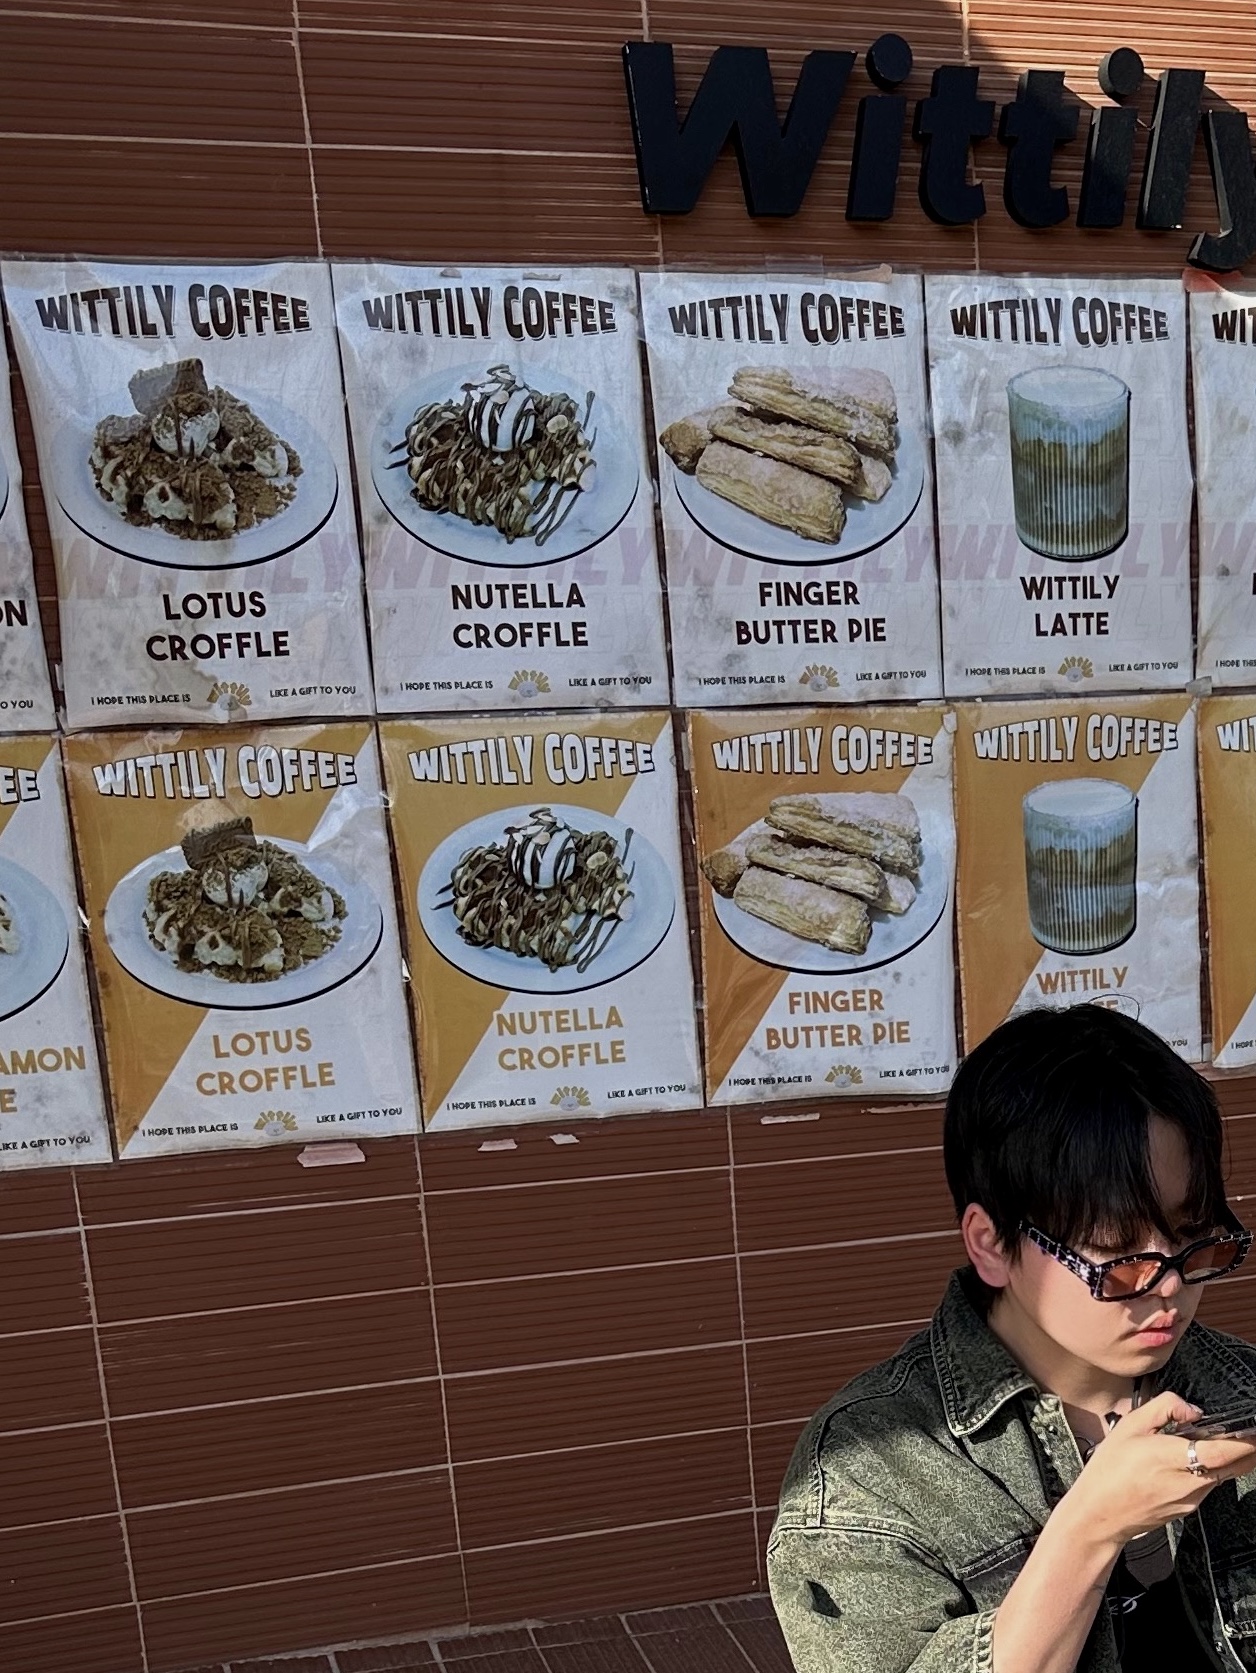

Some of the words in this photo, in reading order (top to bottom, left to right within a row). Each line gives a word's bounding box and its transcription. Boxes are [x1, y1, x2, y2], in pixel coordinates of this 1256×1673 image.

[35, 284, 177, 338] WITTILY
[188, 283, 312, 341] COFFEE
[362, 286, 492, 339] WITTILY
[504, 285, 618, 341] COFFEE
[668, 293, 789, 343] WITTILY
[800, 292, 907, 346] COFFEE
[949, 297, 1062, 344] WITTILY
[1072, 296, 1170, 347] COFFEE
[452, 582, 586, 610] NUTELLA
[759, 580, 859, 607] FINGER
[1020, 574, 1120, 600] WITTILY
[163, 592, 267, 621] LOTUS
[453, 621, 588, 650] CROFFLE
[736, 619, 839, 645] BUTTER
[848, 617, 886, 643] PIE
[1035, 611, 1109, 637] LATTE
[146, 631, 290, 661] CROFFLE
[405, 682, 431, 690] HOPE
[433, 682, 452, 690] THIS
[454, 681, 483, 689] PLACE
[485, 680, 493, 689] IS
[569, 678, 588, 686] LIKE
[598, 677, 617, 685] GIFT
[619, 677, 631, 685] TO
[633, 676, 652, 684] YOU
[703, 677, 726, 685] HOPE
[728, 676, 747, 685] THIS
[749, 676, 776, 684] PLACE
[778, 675, 785, 683] IS
[856, 672, 872, 681] LIKE
[881, 671, 897, 680] GIFT
[899, 671, 908, 679] TO
[910, 670, 927, 678] YOU
[10, 699, 34, 709] YOU
[97, 696, 124, 705] HOPE
[126, 695, 147, 704] THIS
[149, 694, 180, 703] PLACE
[182, 694, 191, 703] IS
[270, 689, 288, 698] LIKE
[299, 686, 317, 695] GIFT
[319, 686, 333, 694] TO
[335, 686, 356, 694] YOU
[712, 727, 822, 774] WITTILY
[831, 725, 934, 774] COFFEE
[973, 716, 1079, 762] WITTILY
[1086, 714, 1178, 762] COFFEE
[93, 747, 227, 798] WITTILY
[237, 745, 357, 798] COFFEE
[408, 735, 534, 785] WITTILY
[545, 733, 656, 786] COFFEE
[1036, 966, 1128, 995] WITTILY
[788, 989, 884, 1016] FINGER
[496, 1006, 624, 1037] NUTELLA
[766, 1024, 862, 1050] BUTTER
[873, 1021, 911, 1045] PIE
[212, 1027, 312, 1059] LOTUS
[498, 1039, 627, 1071] CROFFLE
[196, 1062, 336, 1096] CROFFLE
[733, 1077, 756, 1086] HOPE
[758, 1076, 776, 1085] THIS
[879, 1070, 896, 1078] LIKE
[905, 1068, 922, 1076] GIFT
[924, 1067, 934, 1075] TO
[935, 1064, 950, 1073] YOU
[452, 1102, 476, 1110] HOPE
[478, 1100, 497, 1108] THIS
[498, 1098, 526, 1107] PLACE
[528, 1097, 536, 1105] IS
[607, 1090, 626, 1099] LIKE
[635, 1087, 653, 1095] GIFT
[655, 1086, 666, 1094] TO
[667, 1084, 686, 1092] YOU
[148, 1128, 174, 1136] HOPE
[176, 1126, 196, 1134] THIS
[198, 1124, 228, 1133] PLACE
[230, 1122, 239, 1131] IS
[316, 1114, 336, 1123] LIKE
[346, 1111, 366, 1120] GIFT
[368, 1110, 380, 1118] TO
[382, 1107, 402, 1116] YOU
[29, 1138, 51, 1148] GIFT
[53, 1138, 66, 1146] TO
[68, 1135, 91, 1144] YOU
